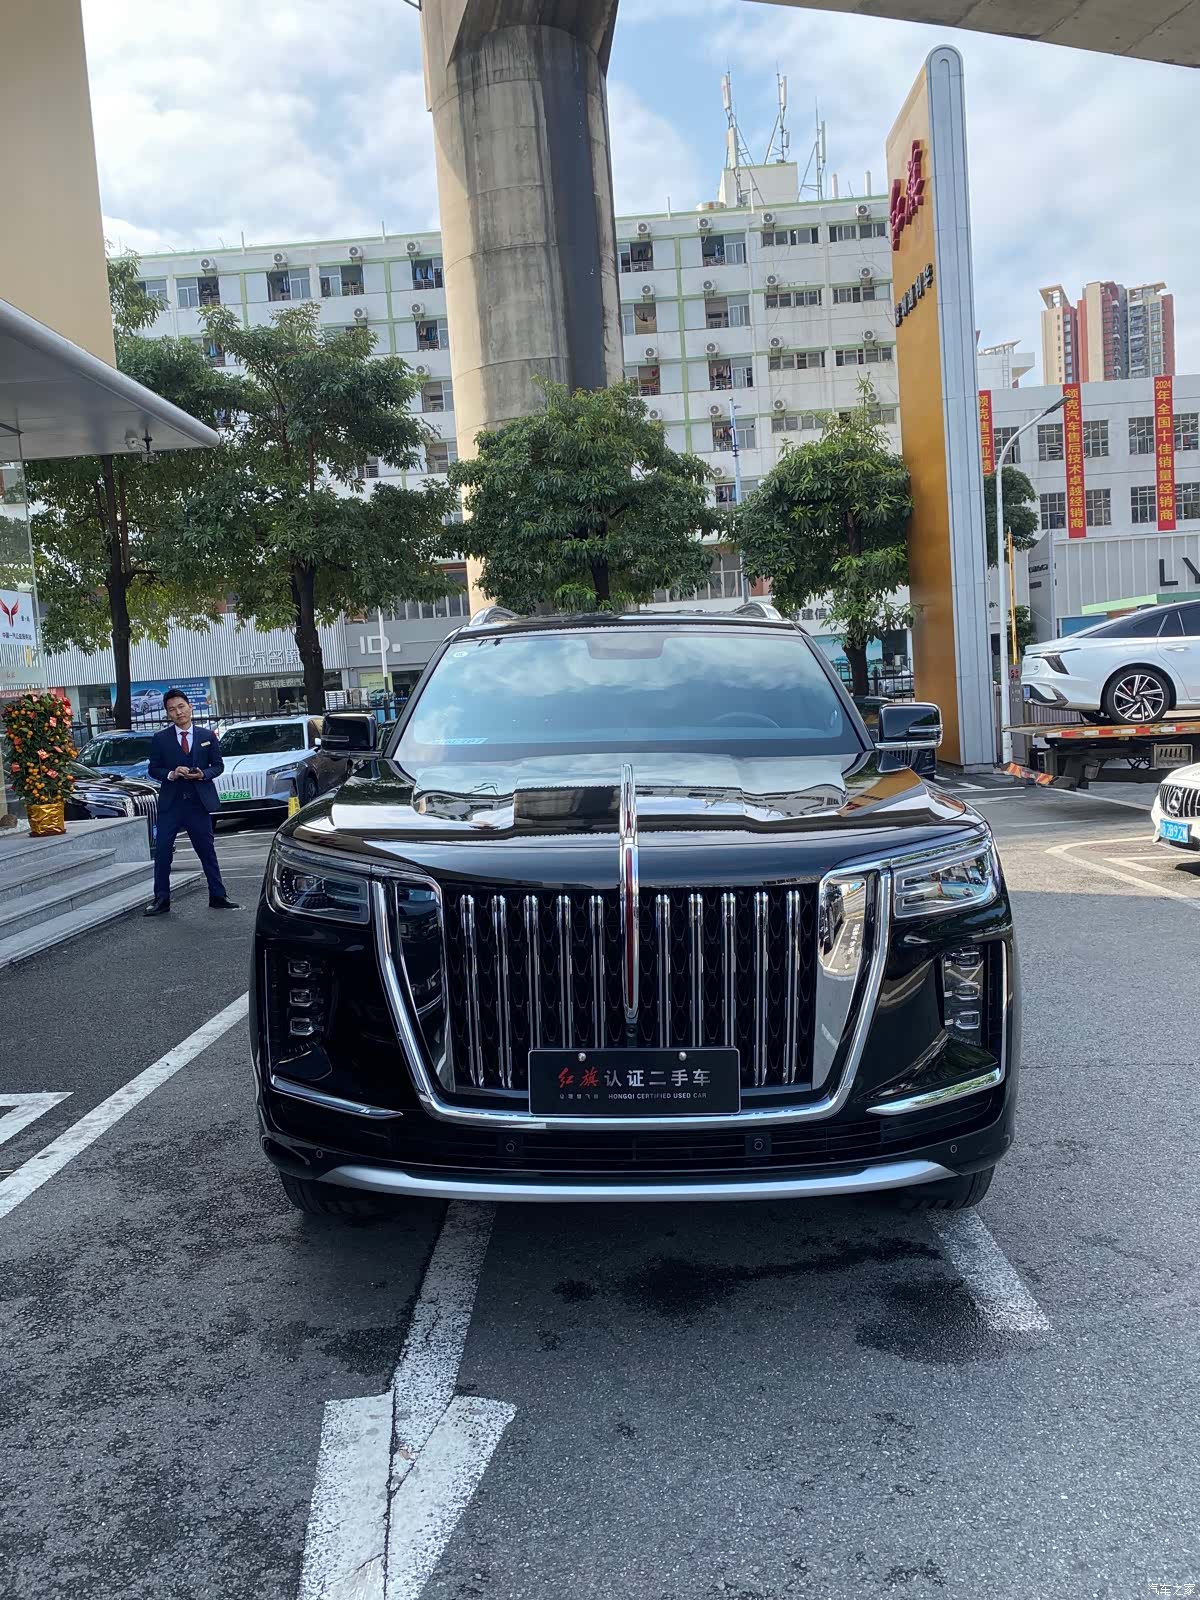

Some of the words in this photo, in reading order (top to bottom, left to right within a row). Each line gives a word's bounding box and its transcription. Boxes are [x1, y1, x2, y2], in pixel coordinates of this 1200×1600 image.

[1064, 388, 1084, 529] 领克汽车售后技术卓越经销商
[1155, 380, 1173, 521] 2024年全国十佳销量经销商
